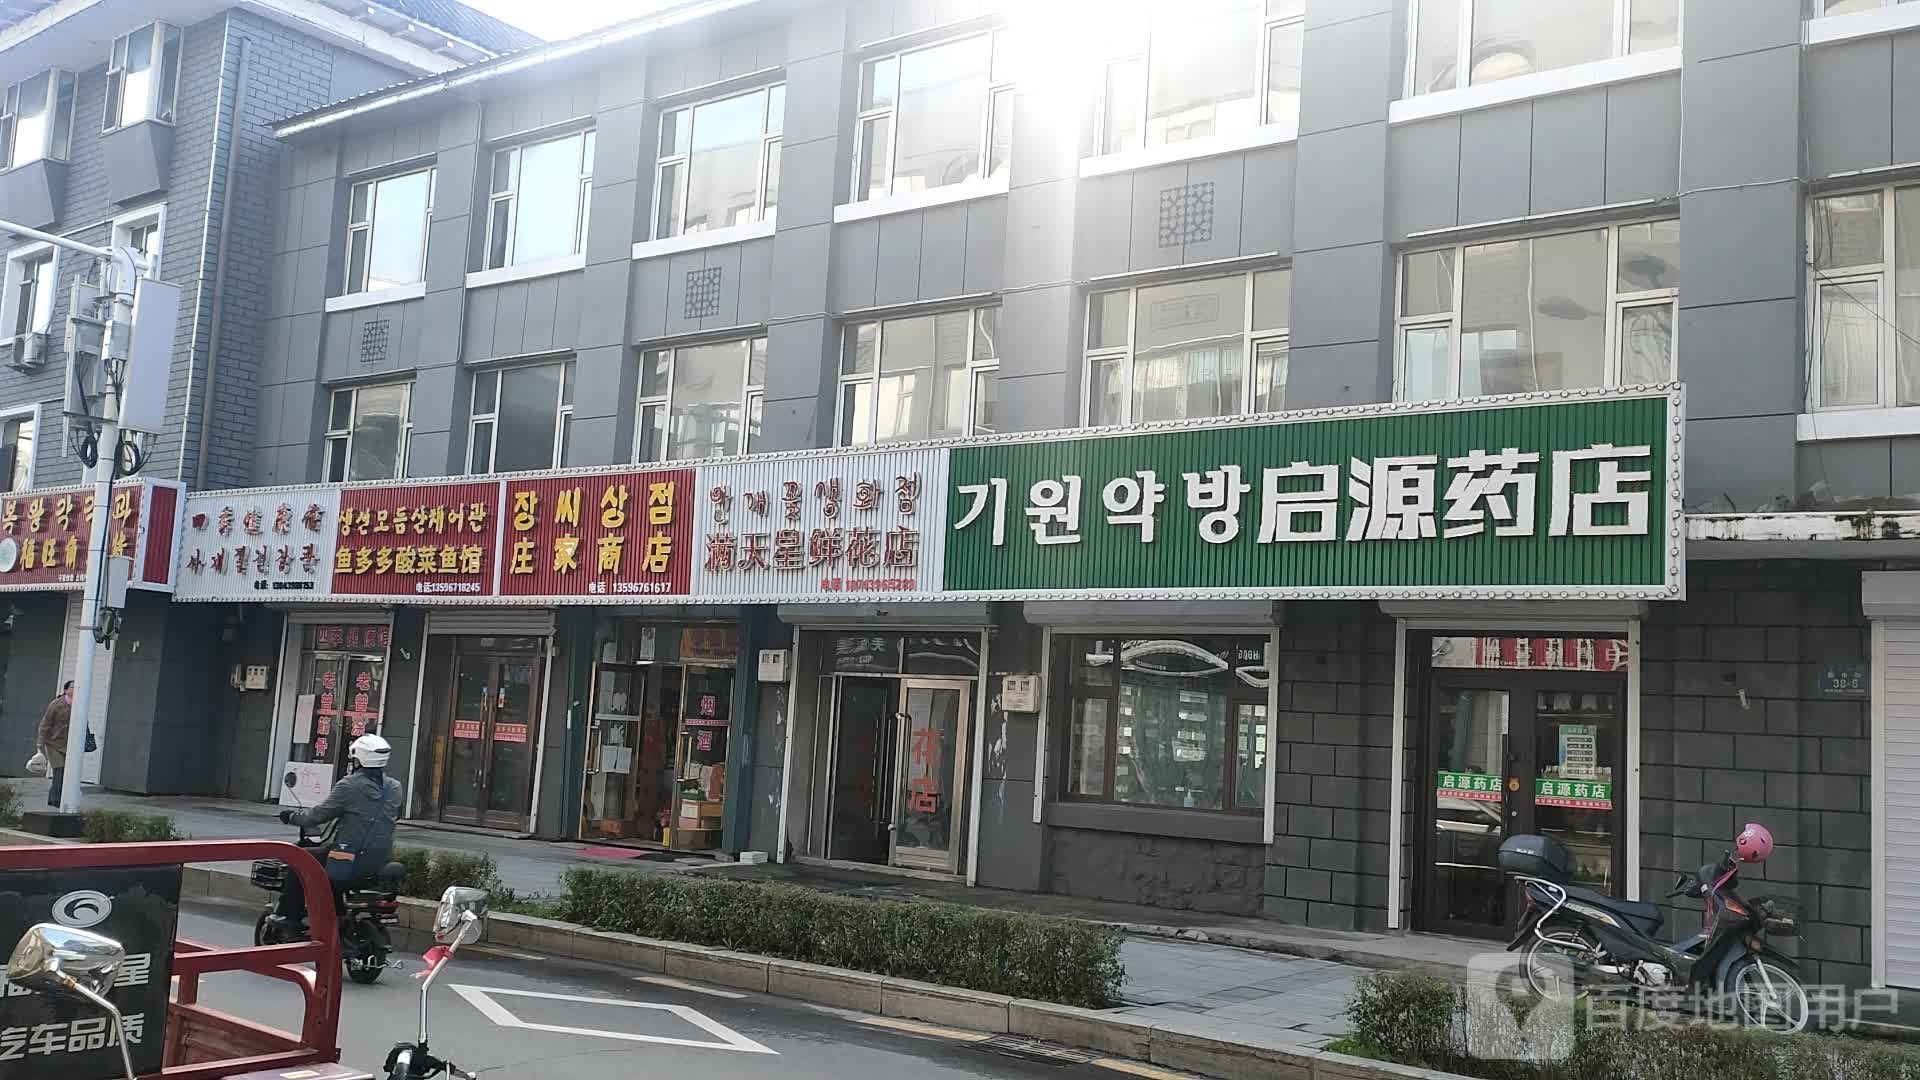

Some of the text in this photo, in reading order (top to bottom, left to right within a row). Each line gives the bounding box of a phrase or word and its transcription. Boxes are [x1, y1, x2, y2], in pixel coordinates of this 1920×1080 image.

[513, 481, 674, 531] 장씨상점
[954, 443, 1652, 546] 기원약방 启源药店
[335, 544, 483, 574] 鱼多多酸菜鱼馆
[510, 532, 672, 575] 庄家商店
[704, 526, 921, 571] 满天星鲜花店
[1442, 774, 1502, 792] 启源药店
[1540, 781, 1606, 799] 启源药店
